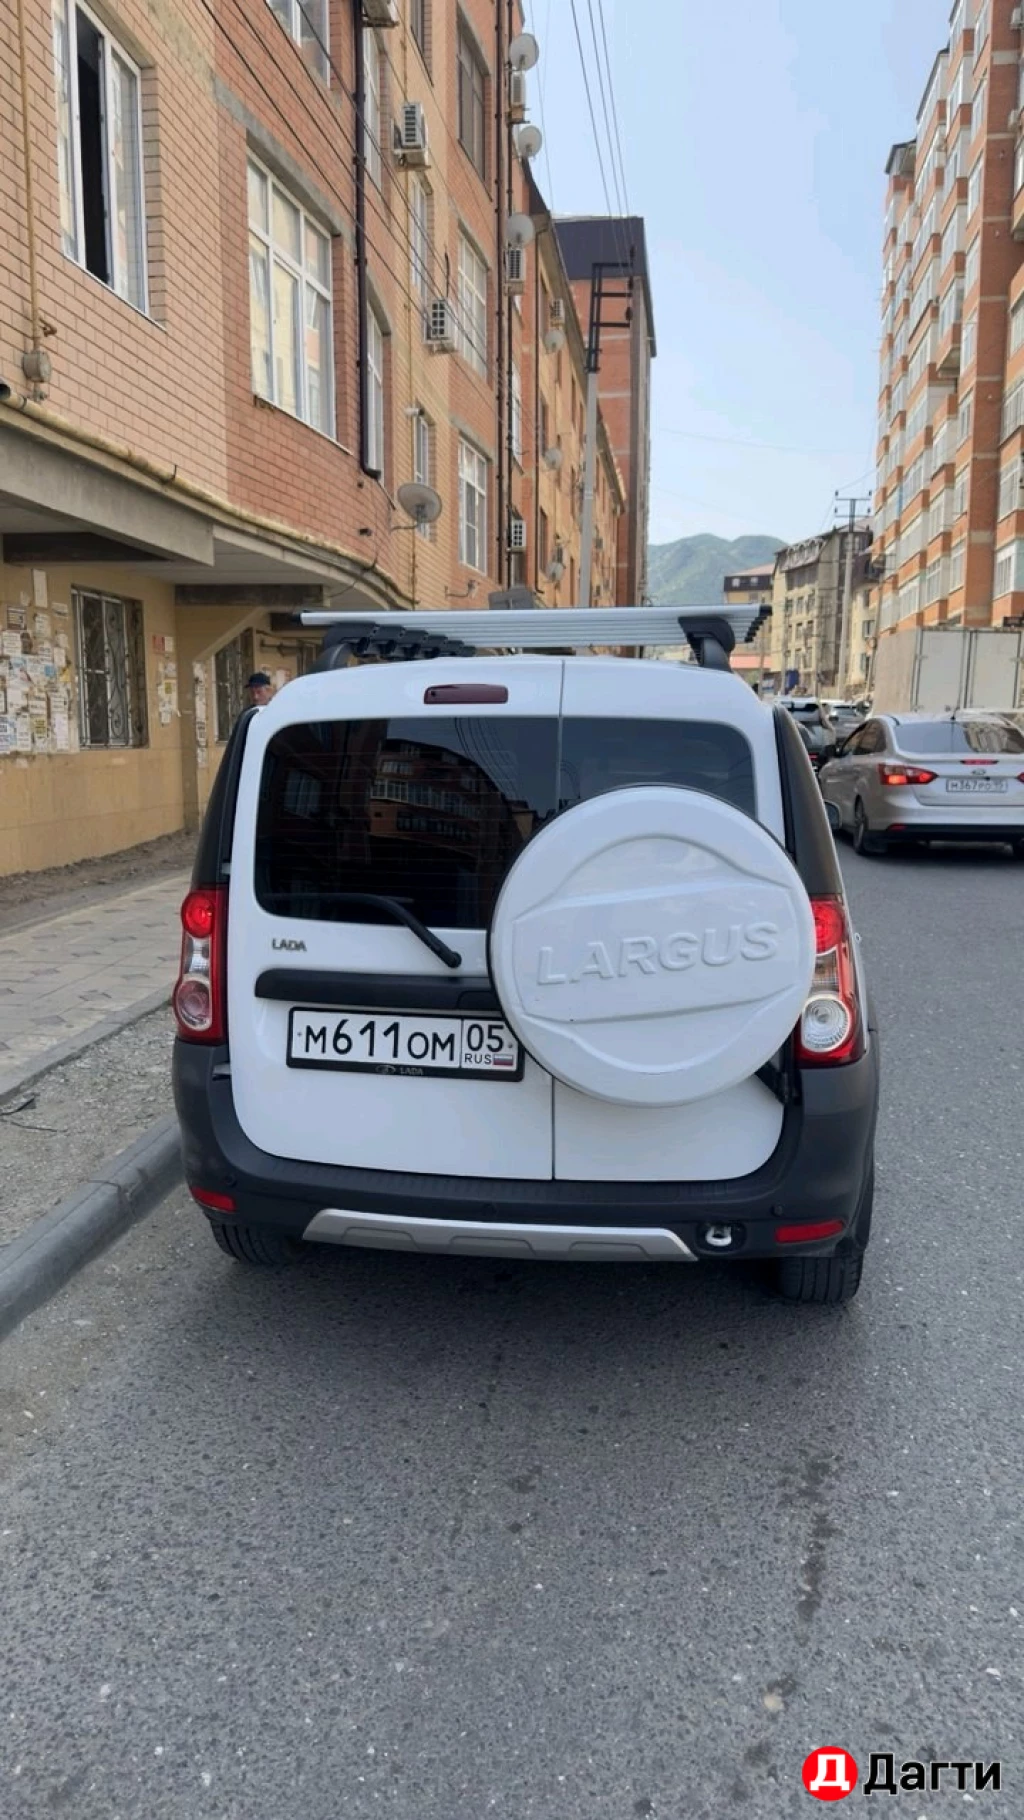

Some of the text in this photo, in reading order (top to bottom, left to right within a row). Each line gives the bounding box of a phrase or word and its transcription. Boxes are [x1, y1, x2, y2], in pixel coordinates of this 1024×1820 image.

[272, 938, 307, 951] LADA
[537, 922, 778, 985] LARGUS
[467, 1024, 504, 1052] 05
[464, 1053, 491, 1065] RUS
[400, 1067, 424, 1076] LADA
